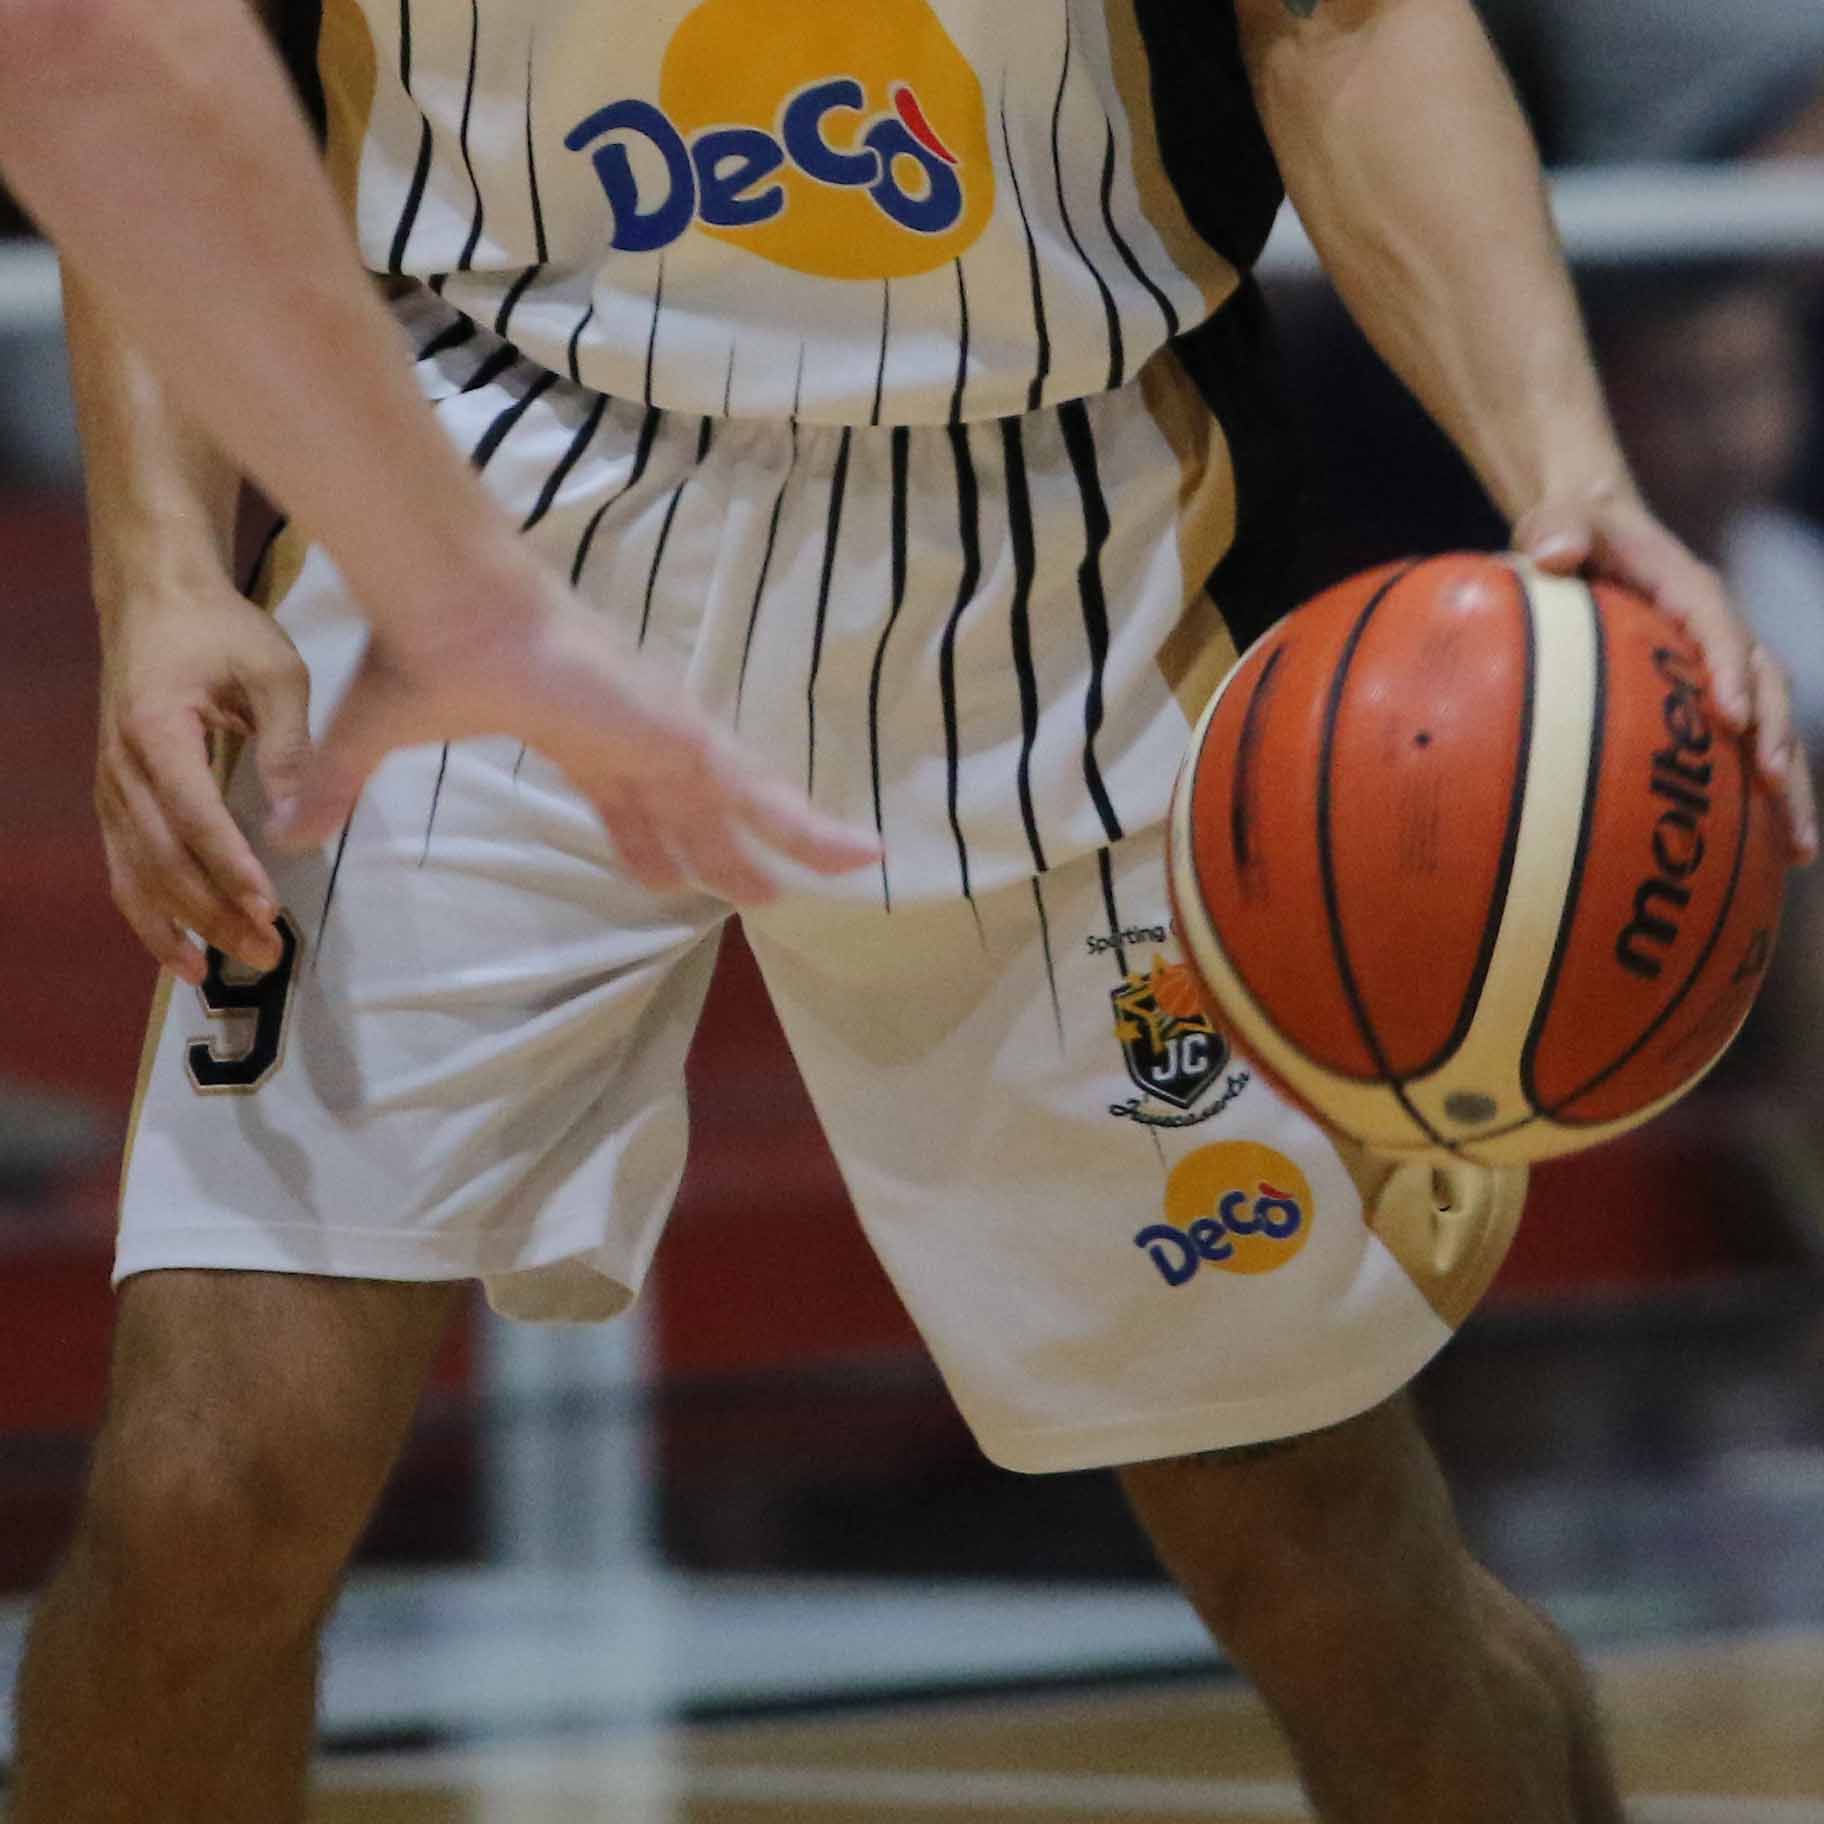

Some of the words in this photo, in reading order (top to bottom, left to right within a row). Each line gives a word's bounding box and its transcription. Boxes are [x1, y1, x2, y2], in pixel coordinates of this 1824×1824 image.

[1616, 646, 1714, 978] molten
[186, 908, 302, 1095] 9
[1151, 1032, 1209, 1081] JC
